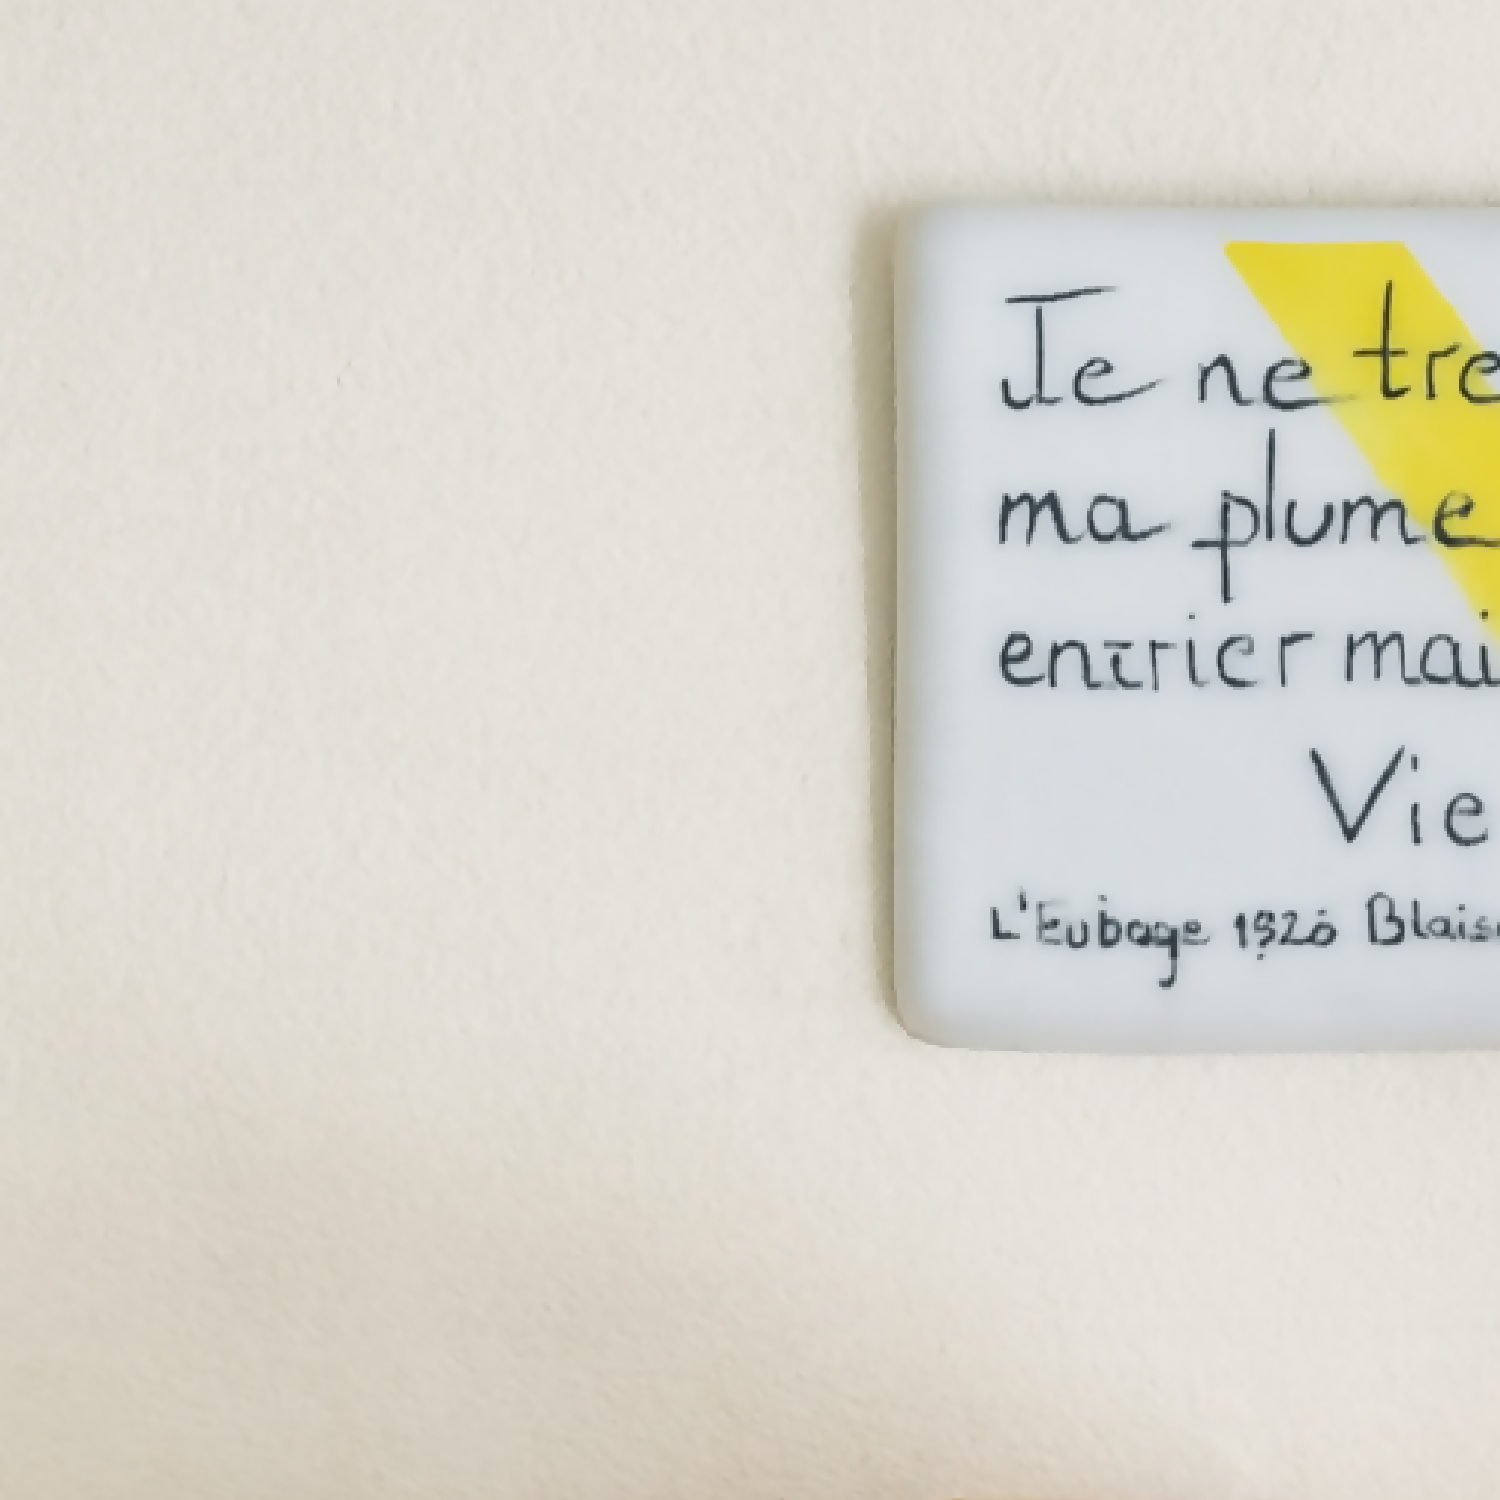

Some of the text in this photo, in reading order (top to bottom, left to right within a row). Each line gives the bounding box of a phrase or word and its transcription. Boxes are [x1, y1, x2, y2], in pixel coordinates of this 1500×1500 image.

[1000, 285, 1160, 411] Je
[1196, 350, 1352, 413] ne
[997, 488, 1170, 546] ma
[1307, 746, 1492, 848] Vie
